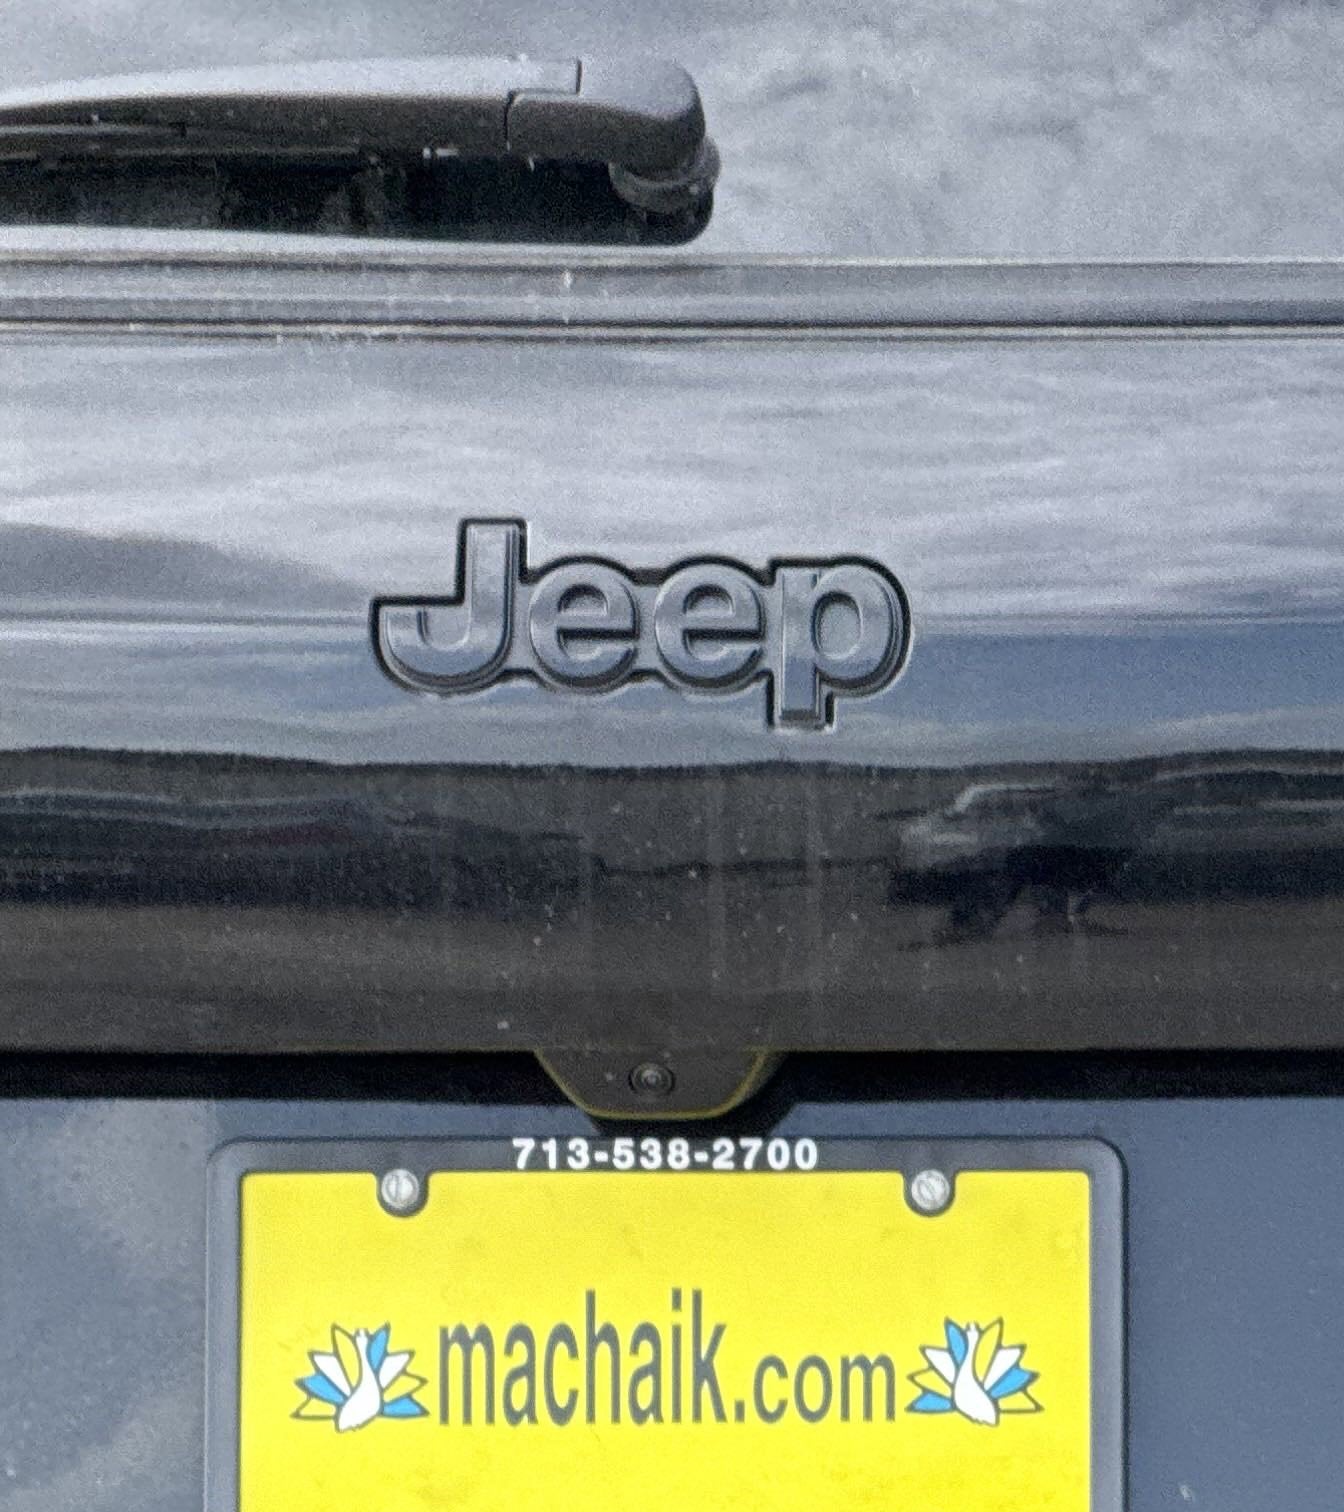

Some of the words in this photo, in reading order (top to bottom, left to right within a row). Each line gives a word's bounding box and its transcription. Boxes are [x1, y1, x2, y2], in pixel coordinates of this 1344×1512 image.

[370, 516, 913, 731] Jeep
[511, 1137, 819, 1171] 713-538-2700
[439, 1287, 896, 1427] machaik.com
